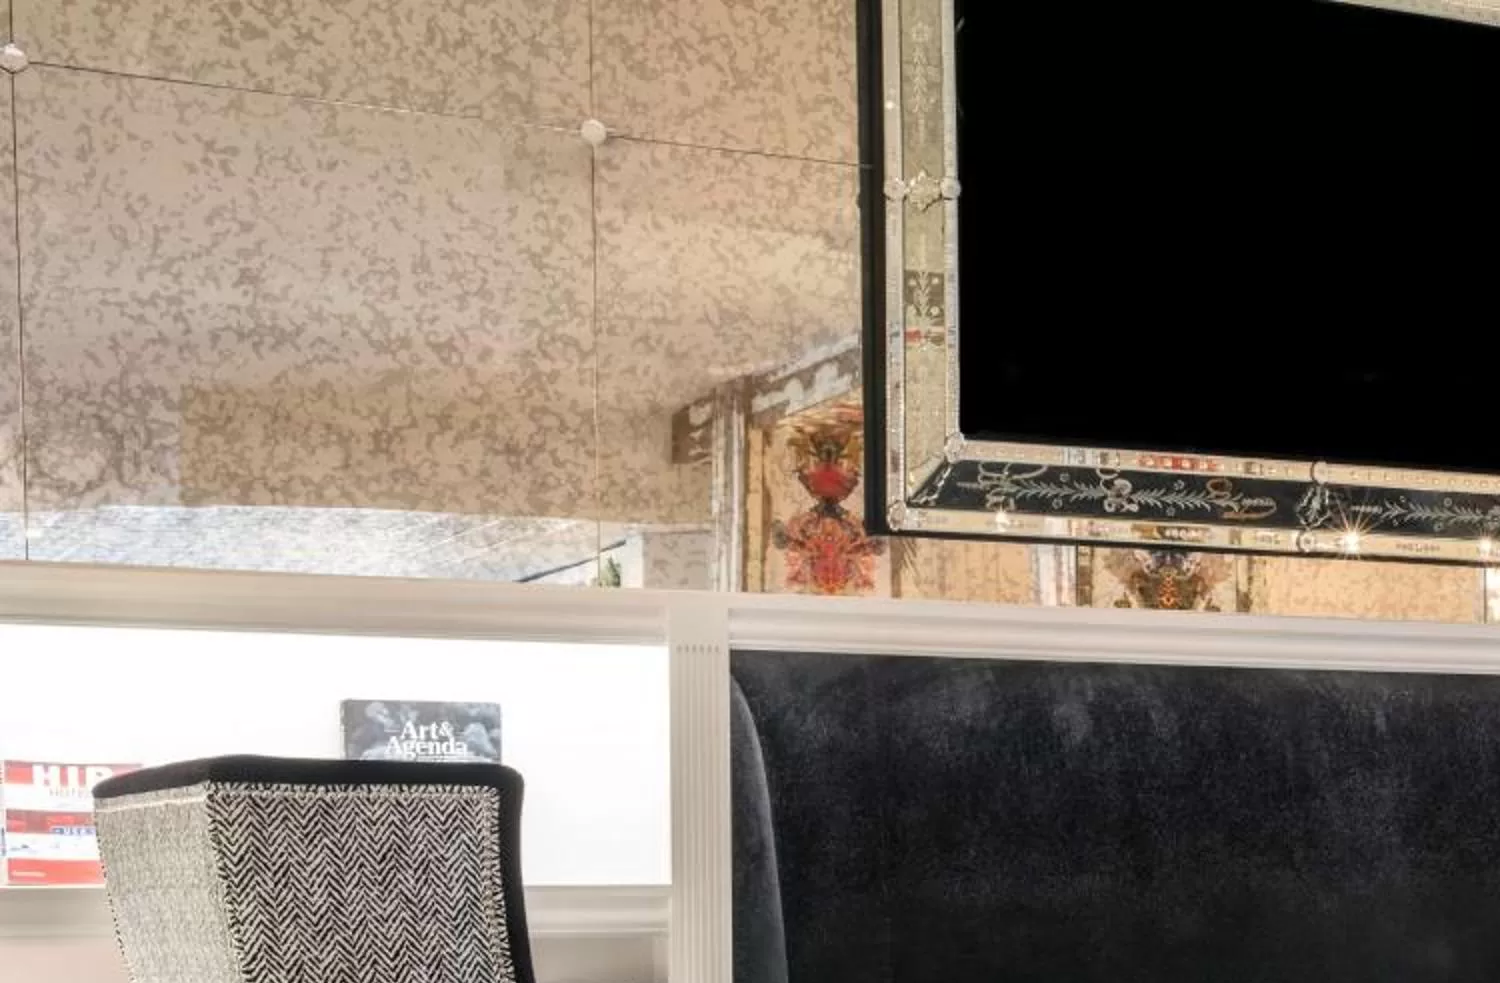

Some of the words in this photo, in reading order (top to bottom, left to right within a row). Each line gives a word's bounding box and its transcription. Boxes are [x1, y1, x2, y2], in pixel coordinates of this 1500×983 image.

[401, 720, 454, 740] Art&
[384, 735, 468, 761] Agenda
[33, 765, 113, 788] HIP
